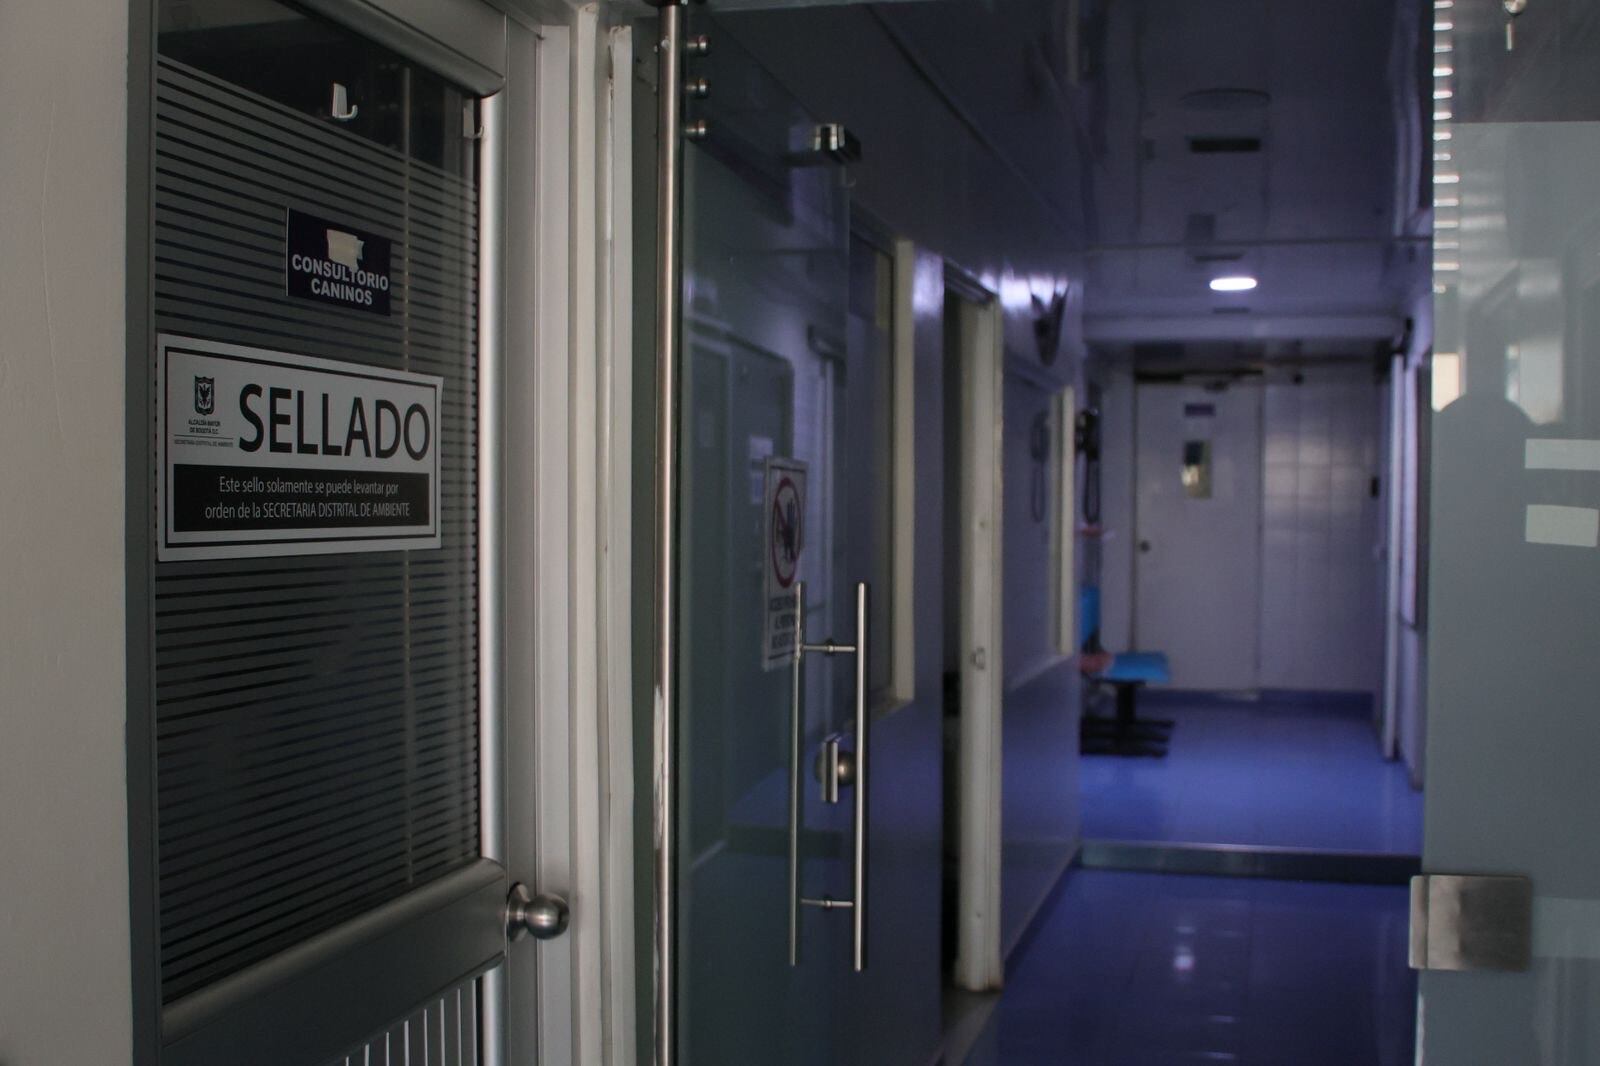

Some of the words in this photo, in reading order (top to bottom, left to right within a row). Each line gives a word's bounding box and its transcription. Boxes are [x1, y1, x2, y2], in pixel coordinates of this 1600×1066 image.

[292, 253, 389, 291] CONSULTORIO
[311, 278, 373, 305] CANINOS
[239, 383, 431, 461] SELLADO
[219, 476, 240, 493] Este
[242, 476, 265, 493] sello
[266, 477, 313, 494] solamente
[314, 483, 325, 494] se
[326, 479, 352, 497] puede
[353, 479, 385, 495] levantar
[385, 484, 400, 497] por
[205, 502, 235, 519] orden
[238, 502, 250, 519] de
[252, 502, 261, 518] la
[263, 502, 317, 518] SECRETARIA
[318, 502, 359, 517] DISTRITAL
[360, 502, 371, 517] DE
[372, 502, 411, 517] AMBIENTE
